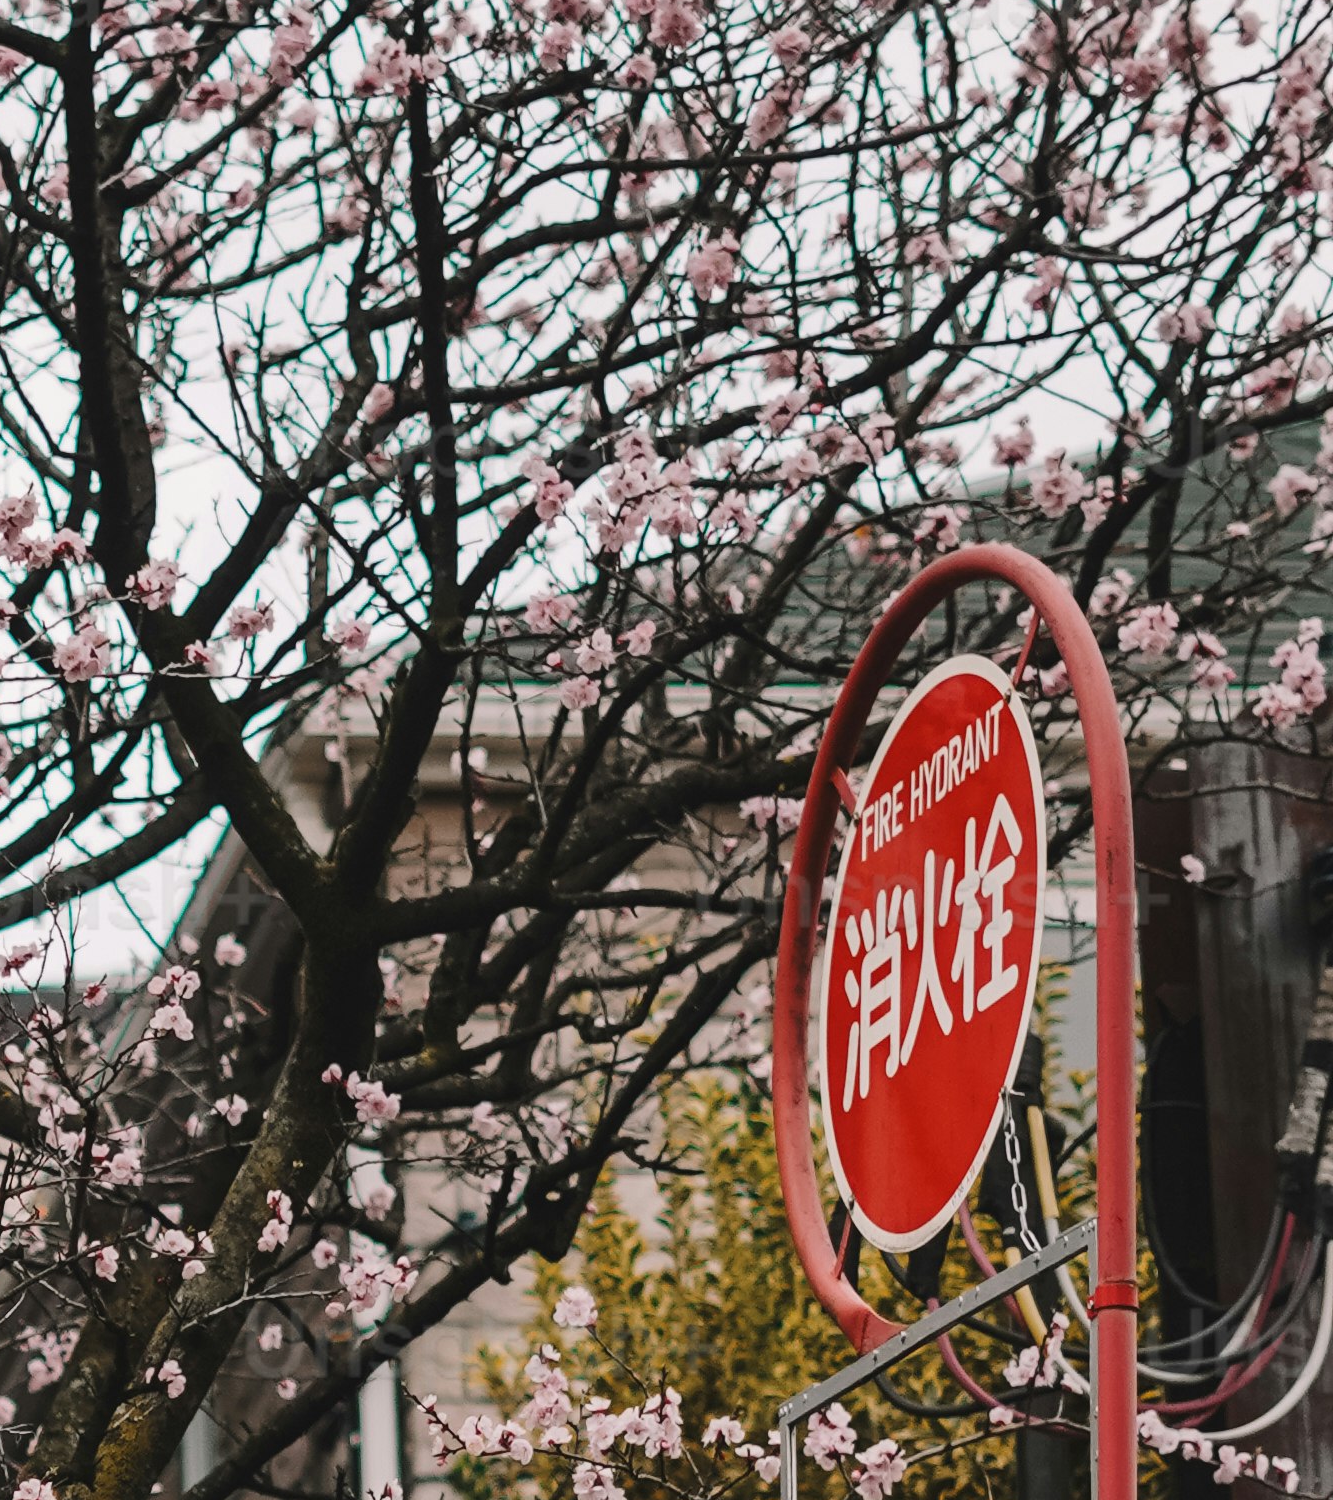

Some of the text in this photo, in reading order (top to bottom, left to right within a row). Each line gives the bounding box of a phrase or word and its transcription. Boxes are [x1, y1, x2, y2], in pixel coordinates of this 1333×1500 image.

[861, 699, 1004, 862] FIRE HYDRANT
[842, 793, 1023, 1113] 消火栓
